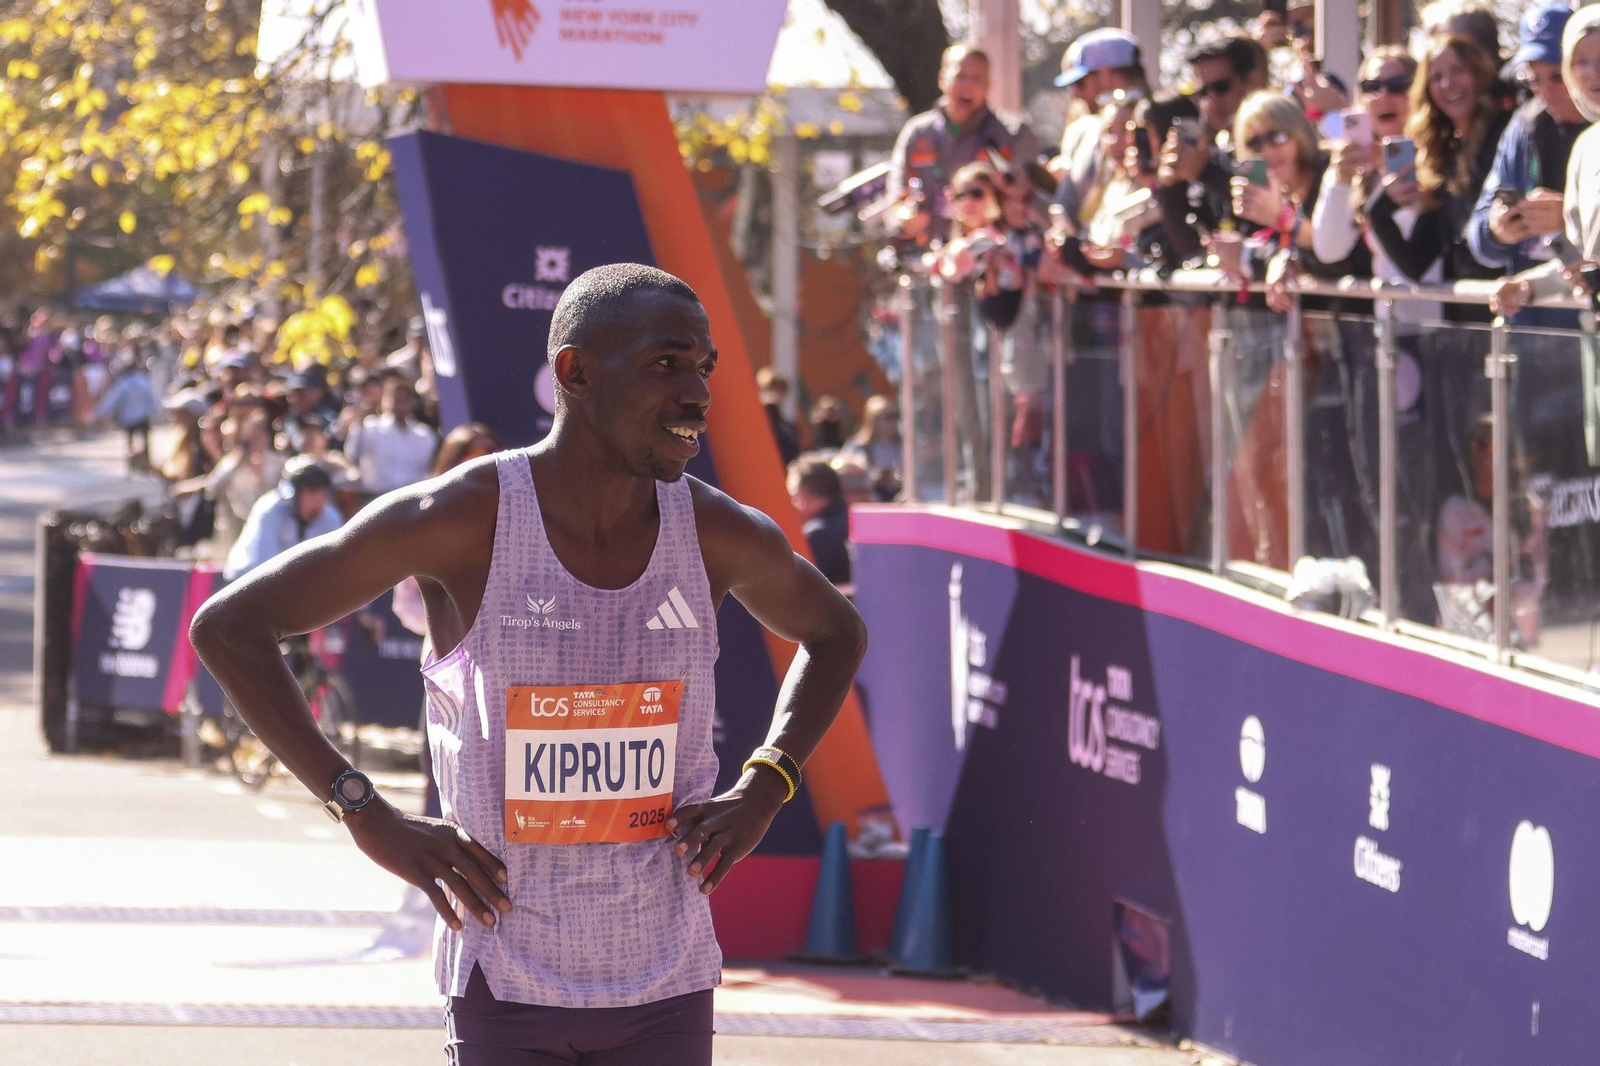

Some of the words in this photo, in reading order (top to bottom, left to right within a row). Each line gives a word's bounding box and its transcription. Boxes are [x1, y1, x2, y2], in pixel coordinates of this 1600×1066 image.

[500, 615, 540, 630] Tirop's
[542, 617, 581, 631] Angels
[572, 691, 595, 699] TATA
[572, 698, 625, 708] CONSULTANCY
[530, 692, 568, 718] tcs
[572, 708, 606, 717] SERVICES
[639, 704, 664, 715] TATA
[1068, 654, 1107, 773] tcs
[524, 737, 665, 794] KIPRUTO
[629, 808, 665, 829] 2025
